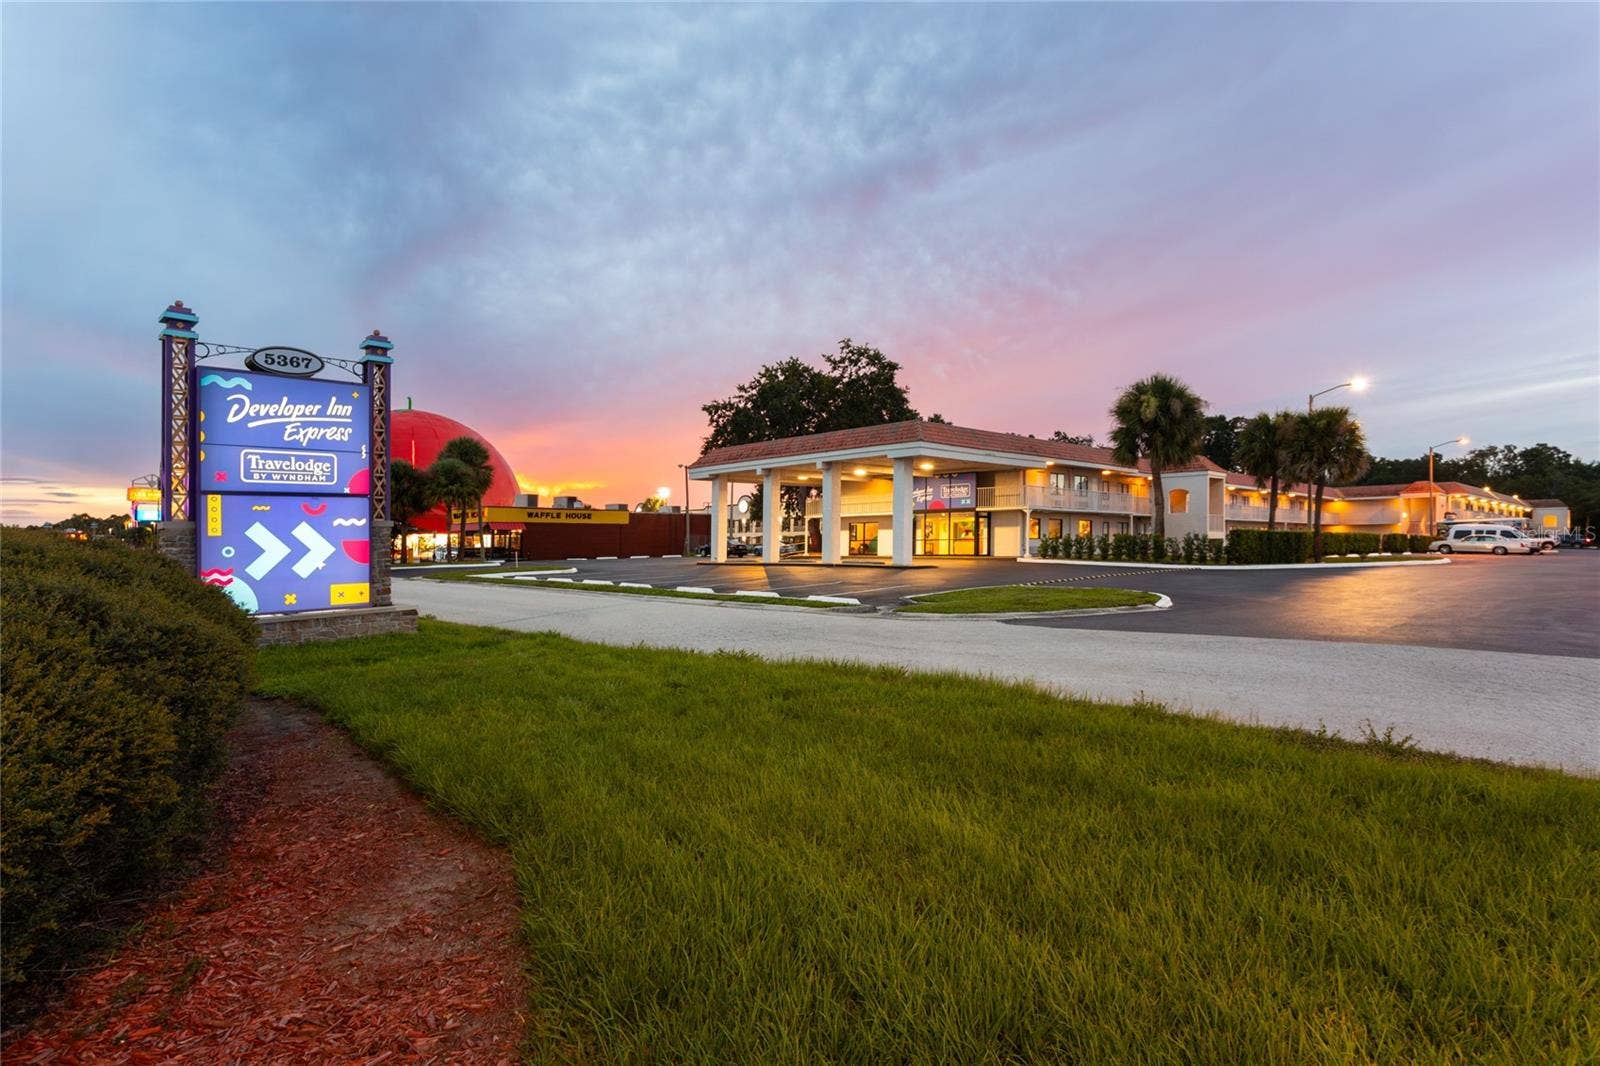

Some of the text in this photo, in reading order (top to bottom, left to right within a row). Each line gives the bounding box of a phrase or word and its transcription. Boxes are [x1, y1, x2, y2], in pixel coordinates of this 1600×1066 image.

[264, 353, 312, 369] 5367
[226, 394, 353, 423] Developer Inn
[283, 422, 353, 447] Express
[246, 454, 332, 476] Travelodge
[272, 473, 327, 482] WYNDHAM
[527, 511, 593, 520] WAFFLE HOUSE
